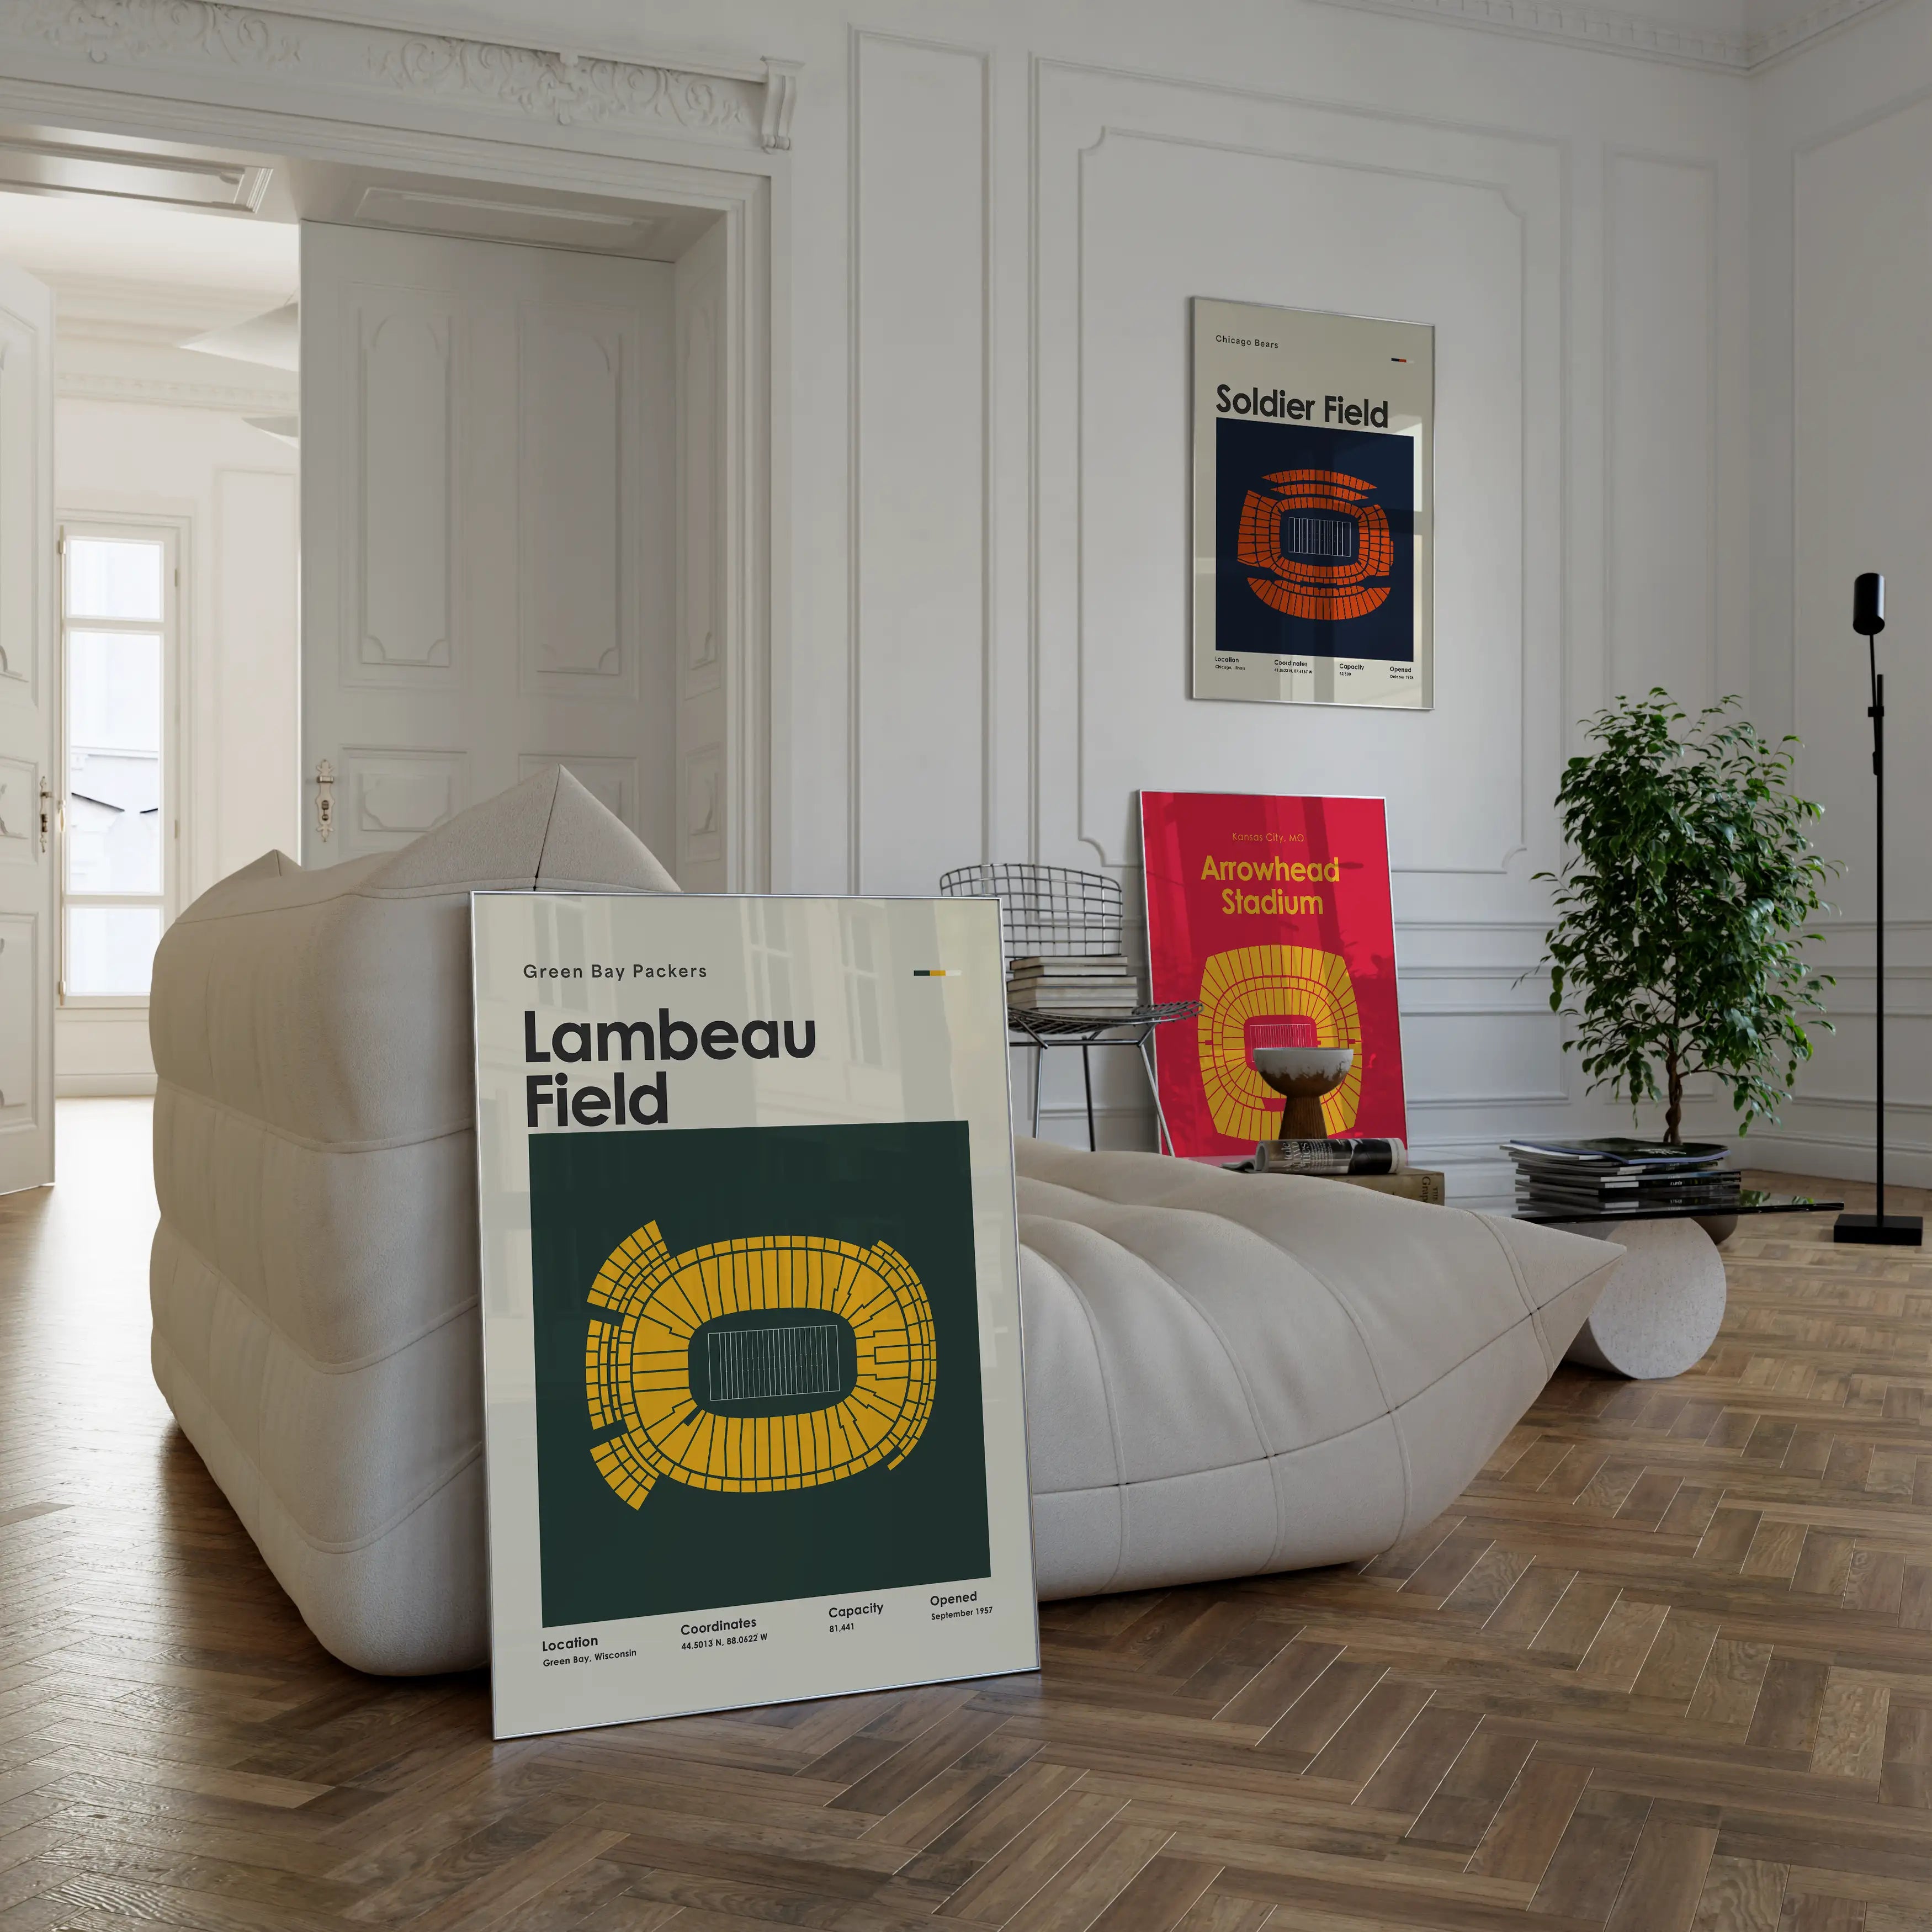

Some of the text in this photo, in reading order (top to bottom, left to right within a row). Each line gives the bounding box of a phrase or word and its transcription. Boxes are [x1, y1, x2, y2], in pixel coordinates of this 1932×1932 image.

[1216, 335, 1278, 349] Chicago Bears
[1216, 384, 1388, 428] Soldier Field
[1232, 832, 1305, 843] Kansas City, MO
[1201, 855, 1340, 883] Arrowhead
[1221, 888, 1324, 915] Stadium
[523, 964, 707, 981] Green Bay Packers
[524, 1008, 816, 1063] Lambeau
[526, 1071, 668, 1128] Field
[1281, 1143, 1292, 1159] tale
[1292, 1142, 1302, 1160] two
[1301, 1143, 1310, 1170] cities
[1419, 1176, 1431, 1203] Grap
[930, 1591, 977, 1607] Opened
[829, 1602, 884, 1618] Capacity
[931, 1606, 993, 1621] September 1957
[681, 1618, 757, 1636] Coordinates
[829, 1622, 854, 1633] 81,441
[542, 1636, 598, 1652] Location
[715, 1638, 724, 1647] N,
[543, 1649, 636, 1667] Green Bay, Wisconsin
